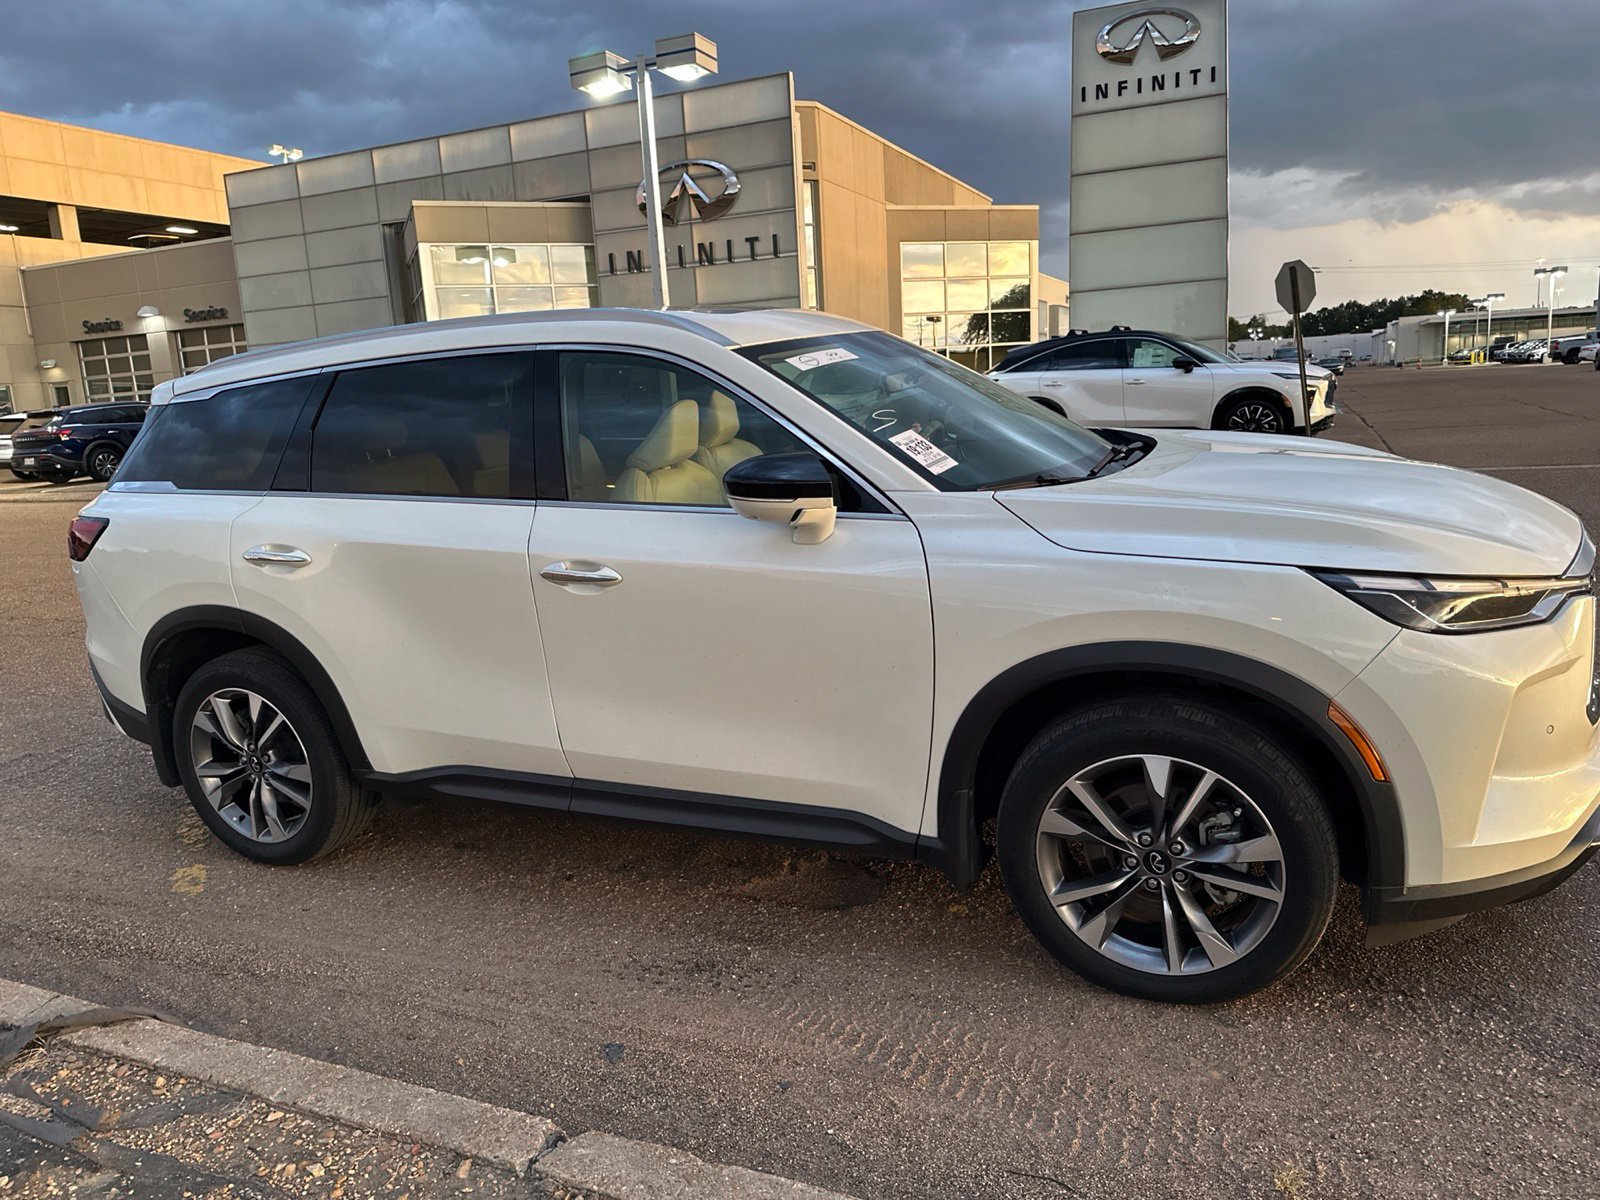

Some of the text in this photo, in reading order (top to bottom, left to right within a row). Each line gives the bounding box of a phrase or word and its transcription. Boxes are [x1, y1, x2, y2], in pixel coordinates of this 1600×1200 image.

[1081, 66, 1216, 102] INFINITI
[608, 234, 779, 275] ININITI
[82, 317, 123, 334] Service
[183, 305, 228, 323] Service
